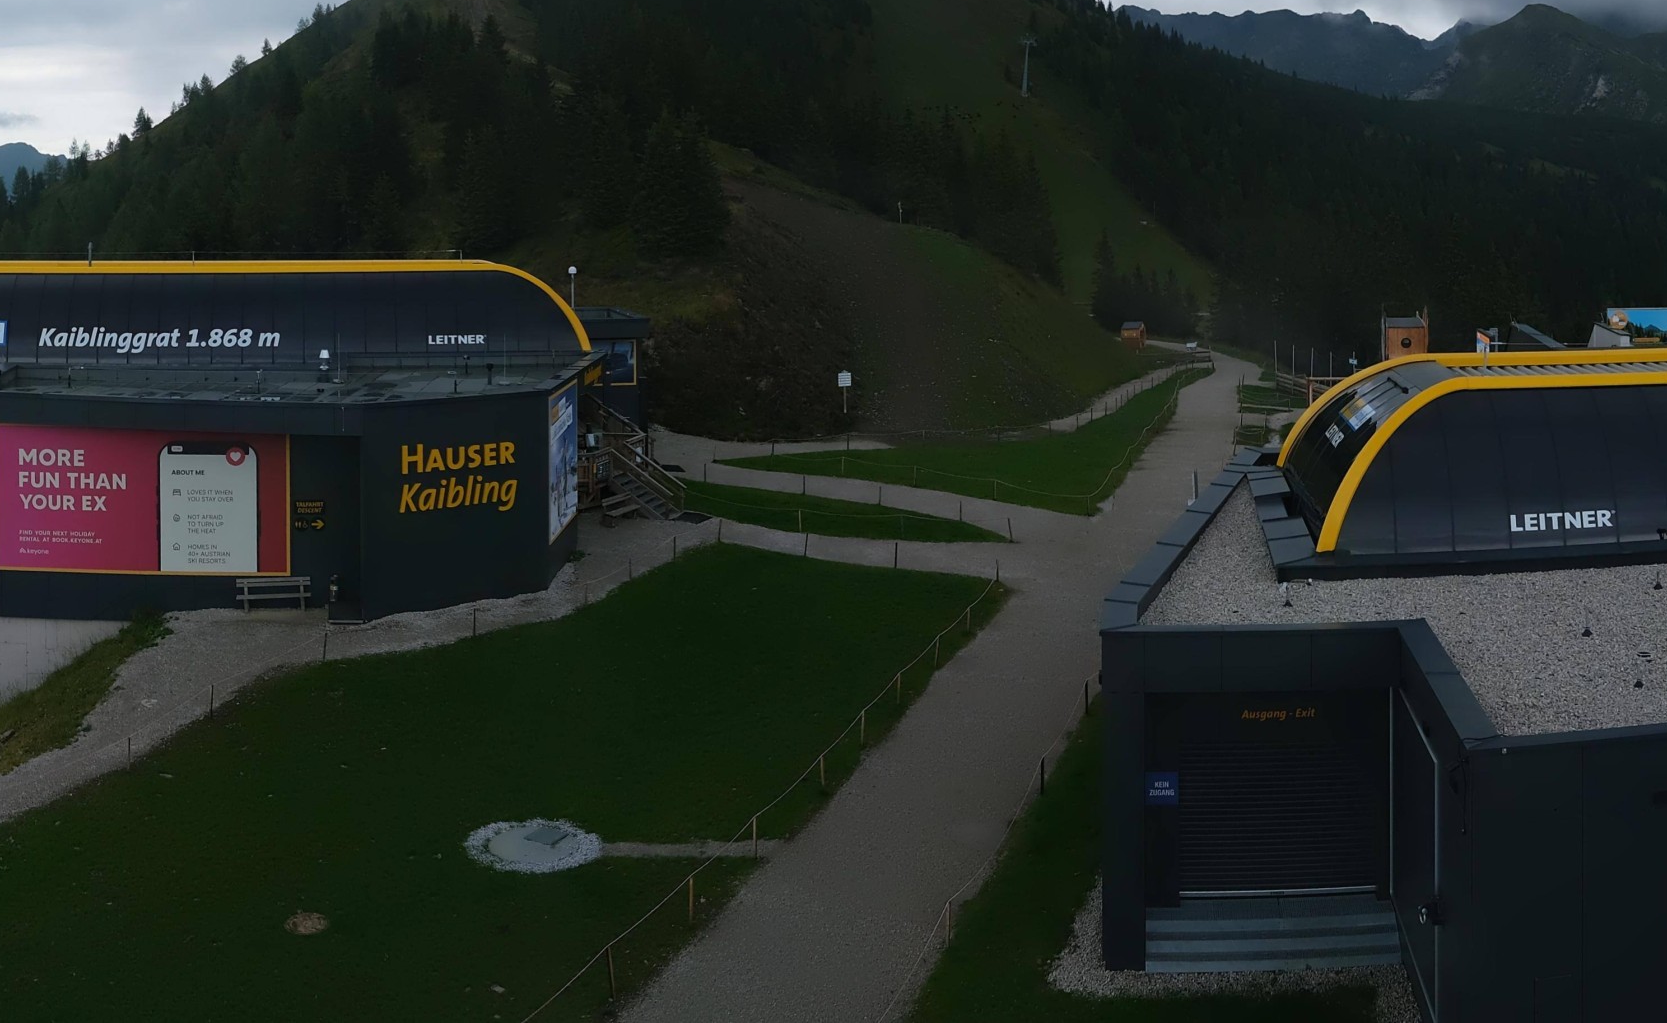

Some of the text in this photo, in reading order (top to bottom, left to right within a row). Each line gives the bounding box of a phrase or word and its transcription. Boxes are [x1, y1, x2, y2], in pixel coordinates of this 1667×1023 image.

[38, 327, 281, 354] Kaiblinggrat 1.868 m
[18, 448, 85, 467] MORE
[402, 442, 515, 474] HAUSER
[18, 471, 127, 490] FUN THAN
[20, 494, 107, 511] YOUR EX
[399, 475, 518, 513] Kaibling
[1241, 709, 1287, 721] Ausgang
[1295, 708, 1316, 718] Exit
